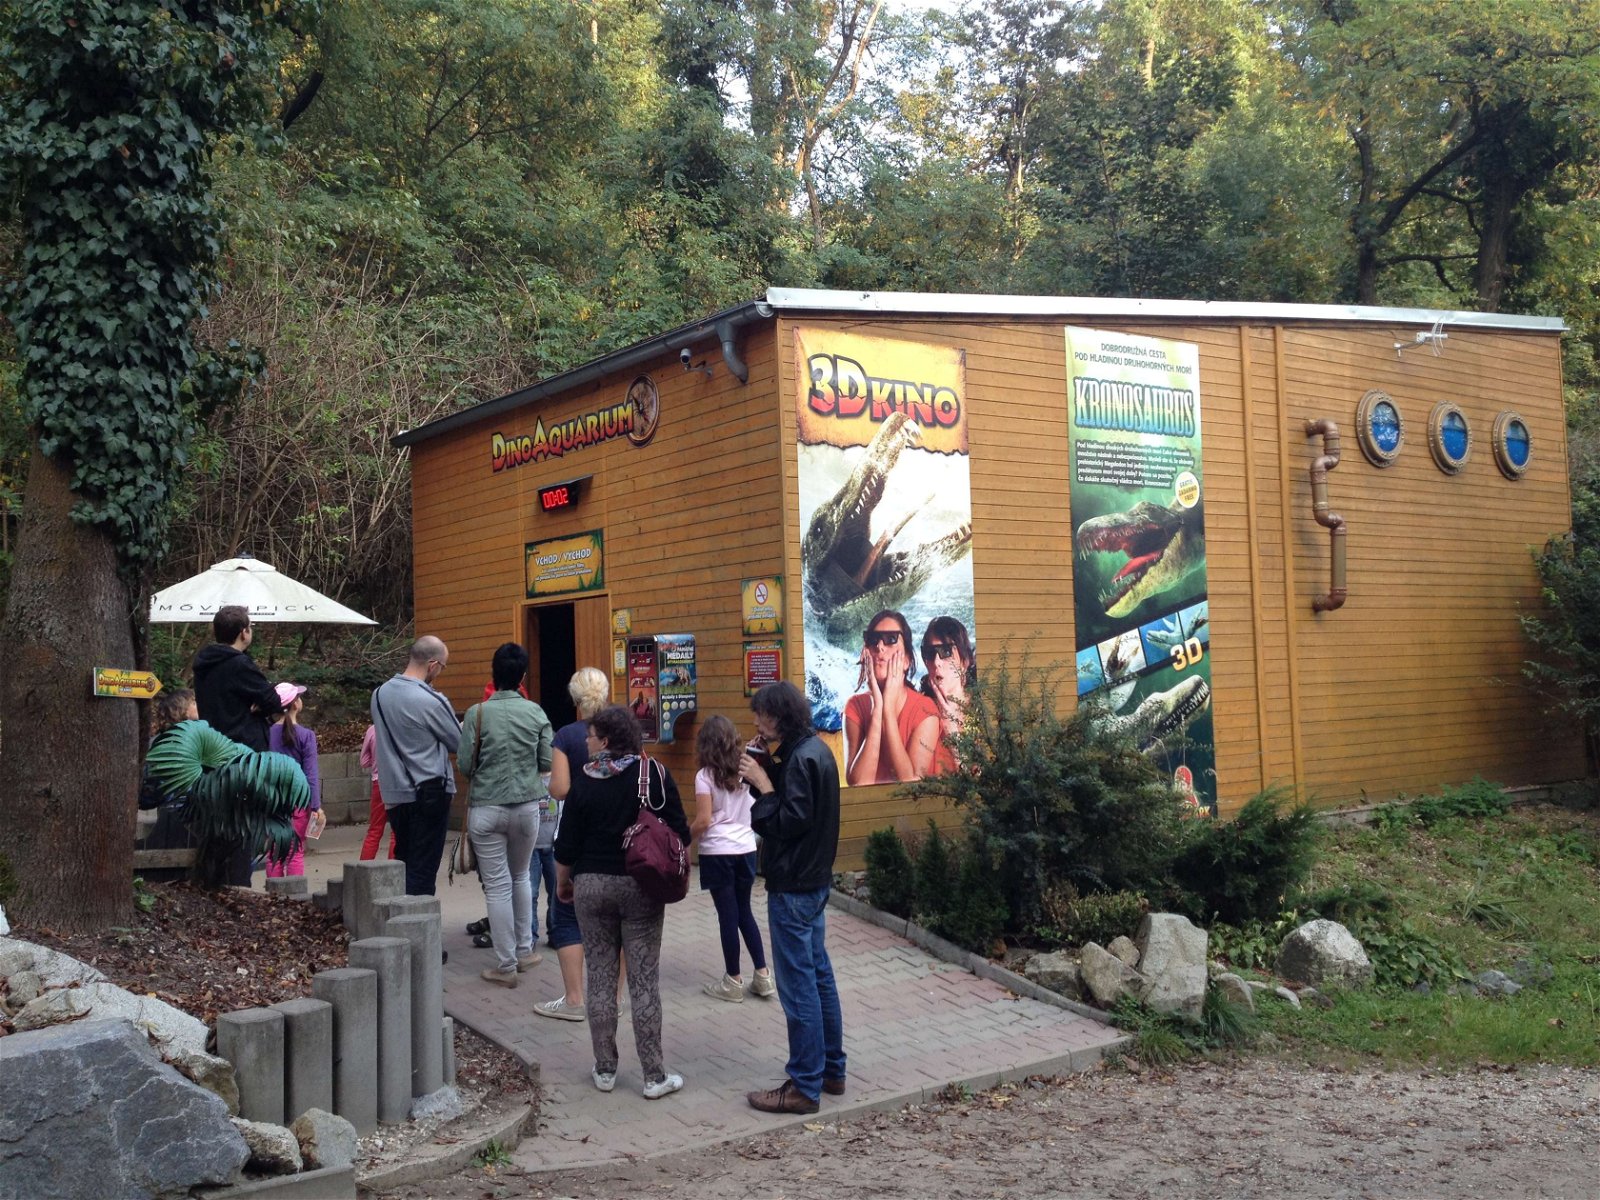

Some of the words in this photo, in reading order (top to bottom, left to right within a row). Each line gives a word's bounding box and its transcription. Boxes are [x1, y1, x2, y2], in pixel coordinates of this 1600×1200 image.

[1075, 352, 1088, 361] POD
[1089, 354, 1123, 366] HLADINOU
[1124, 358, 1174, 373] DRUHOHORNÝCH
[1175, 365, 1192, 375] MORÍ
[1101, 343, 1147, 356] DOBRODRUŽNÁ
[1148, 349, 1166, 359] CESTA
[808, 353, 868, 418] 3D
[869, 376, 961, 429] KINO
[1074, 377, 1195, 438] KRONOSAURUS
[543, 488, 568, 508] 00:02
[1170, 636, 1204, 672] 3D
